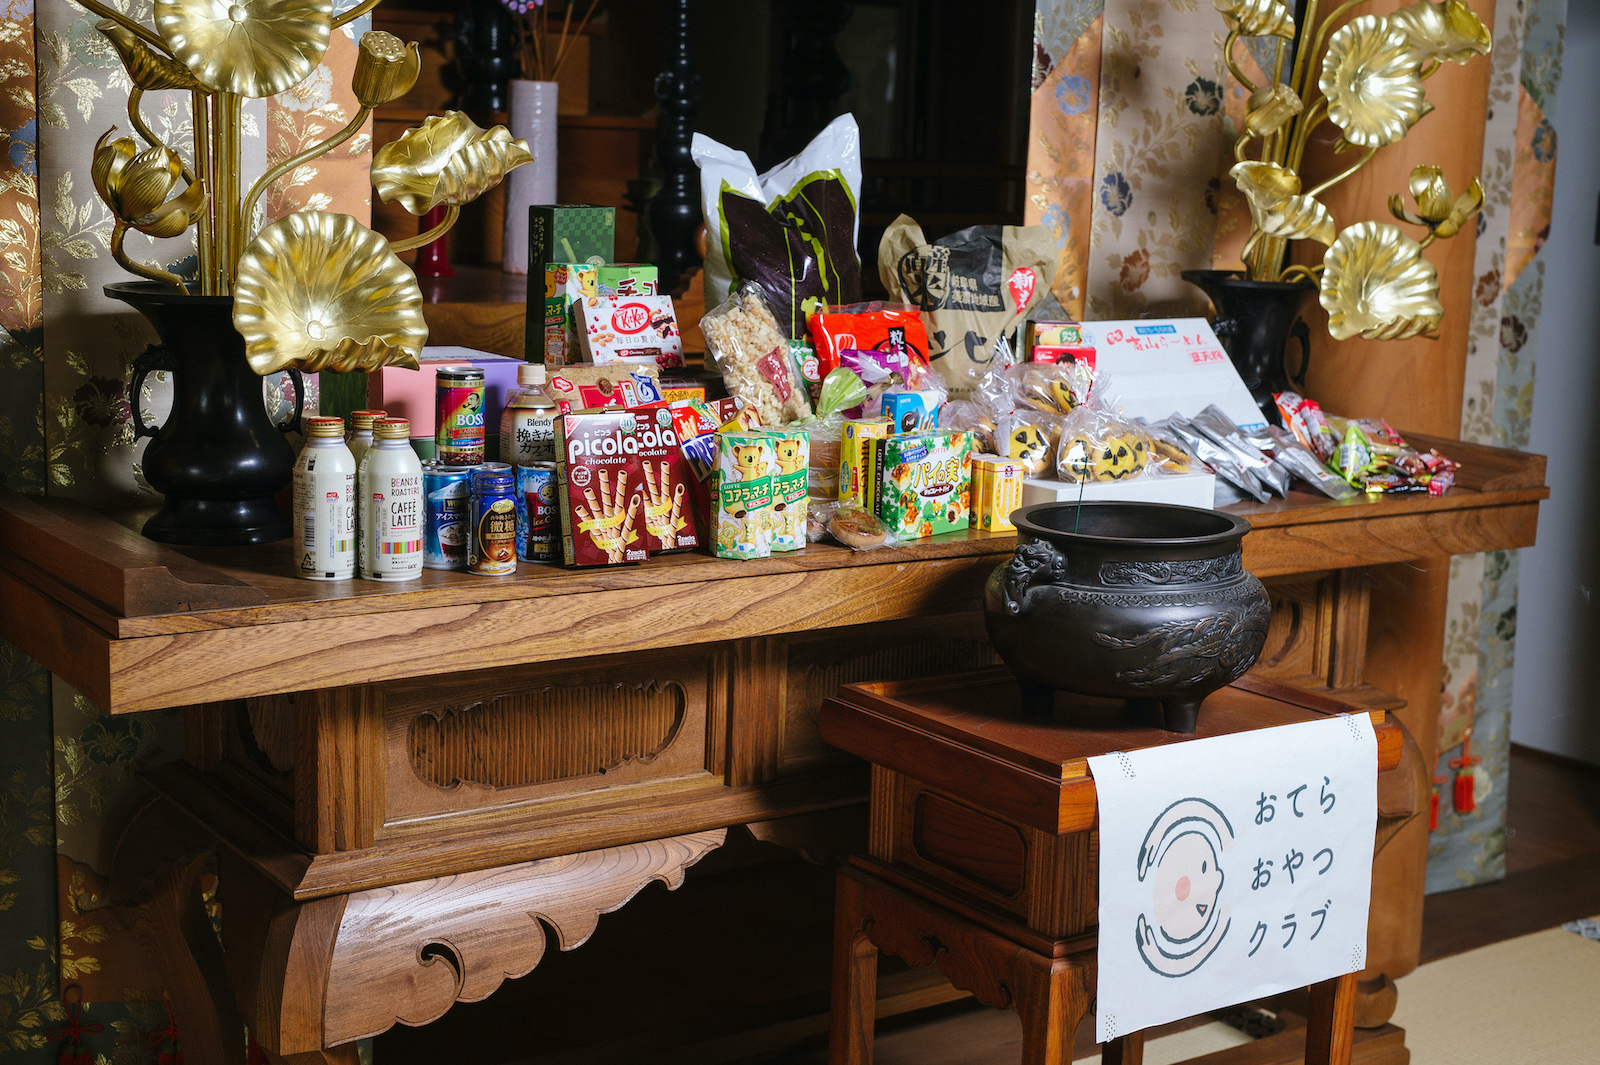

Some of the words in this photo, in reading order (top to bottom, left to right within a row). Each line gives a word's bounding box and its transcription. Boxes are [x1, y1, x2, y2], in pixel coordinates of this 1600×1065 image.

[621, 308, 645, 328] KitKat
[527, 418, 552, 427] Blendy
[568, 430, 638, 465] picola
[585, 457, 627, 465] chocolate
[391, 478, 413, 487] BEANS
[414, 477, 418, 486] &
[913, 456, 960, 488] パイの実
[391, 487, 420, 497] ROASTERS
[725, 482, 769, 503] コアラのマーチ
[391, 514, 417, 527] LATTE
[489, 520, 514, 532] 微糖
[1255, 776, 1336, 825] おてら
[1251, 848, 1334, 890] おやつ
[1248, 900, 1331, 957] クラブ
